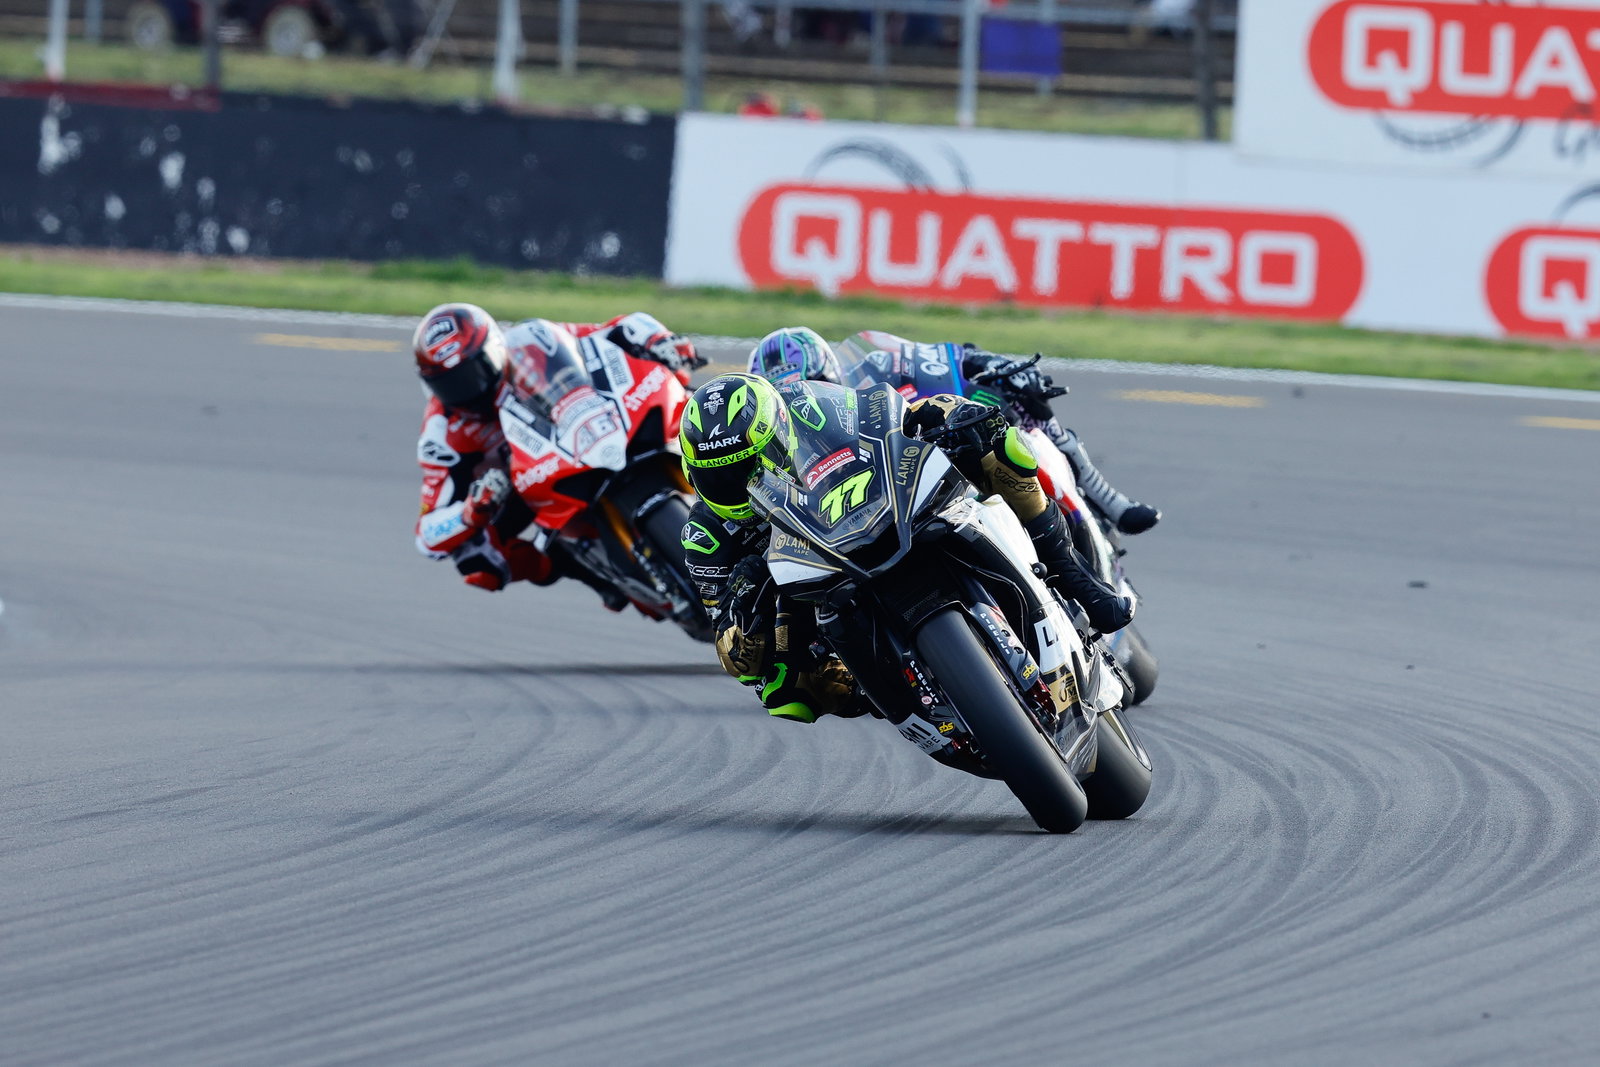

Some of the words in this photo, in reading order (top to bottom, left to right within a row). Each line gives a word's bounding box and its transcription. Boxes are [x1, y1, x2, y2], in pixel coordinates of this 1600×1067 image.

[770, 192, 1318, 308] QUATTRO
[869, 400, 881, 425] LAMI
[698, 435, 742, 451] SHARK
[700, 451, 750, 468] LANGVER
[818, 451, 851, 472] Bennetts
[896, 458, 911, 486] LAMI
[818, 467, 876, 526] 77
[848, 508, 872, 525] YAMAHA
[786, 536, 810, 551] LAMI
[794, 548, 809, 556] VAPE
[980, 612, 1010, 655] PIRELLI
[910, 660, 939, 704] PIRELLI
[1022, 664, 1037, 680] sbs
